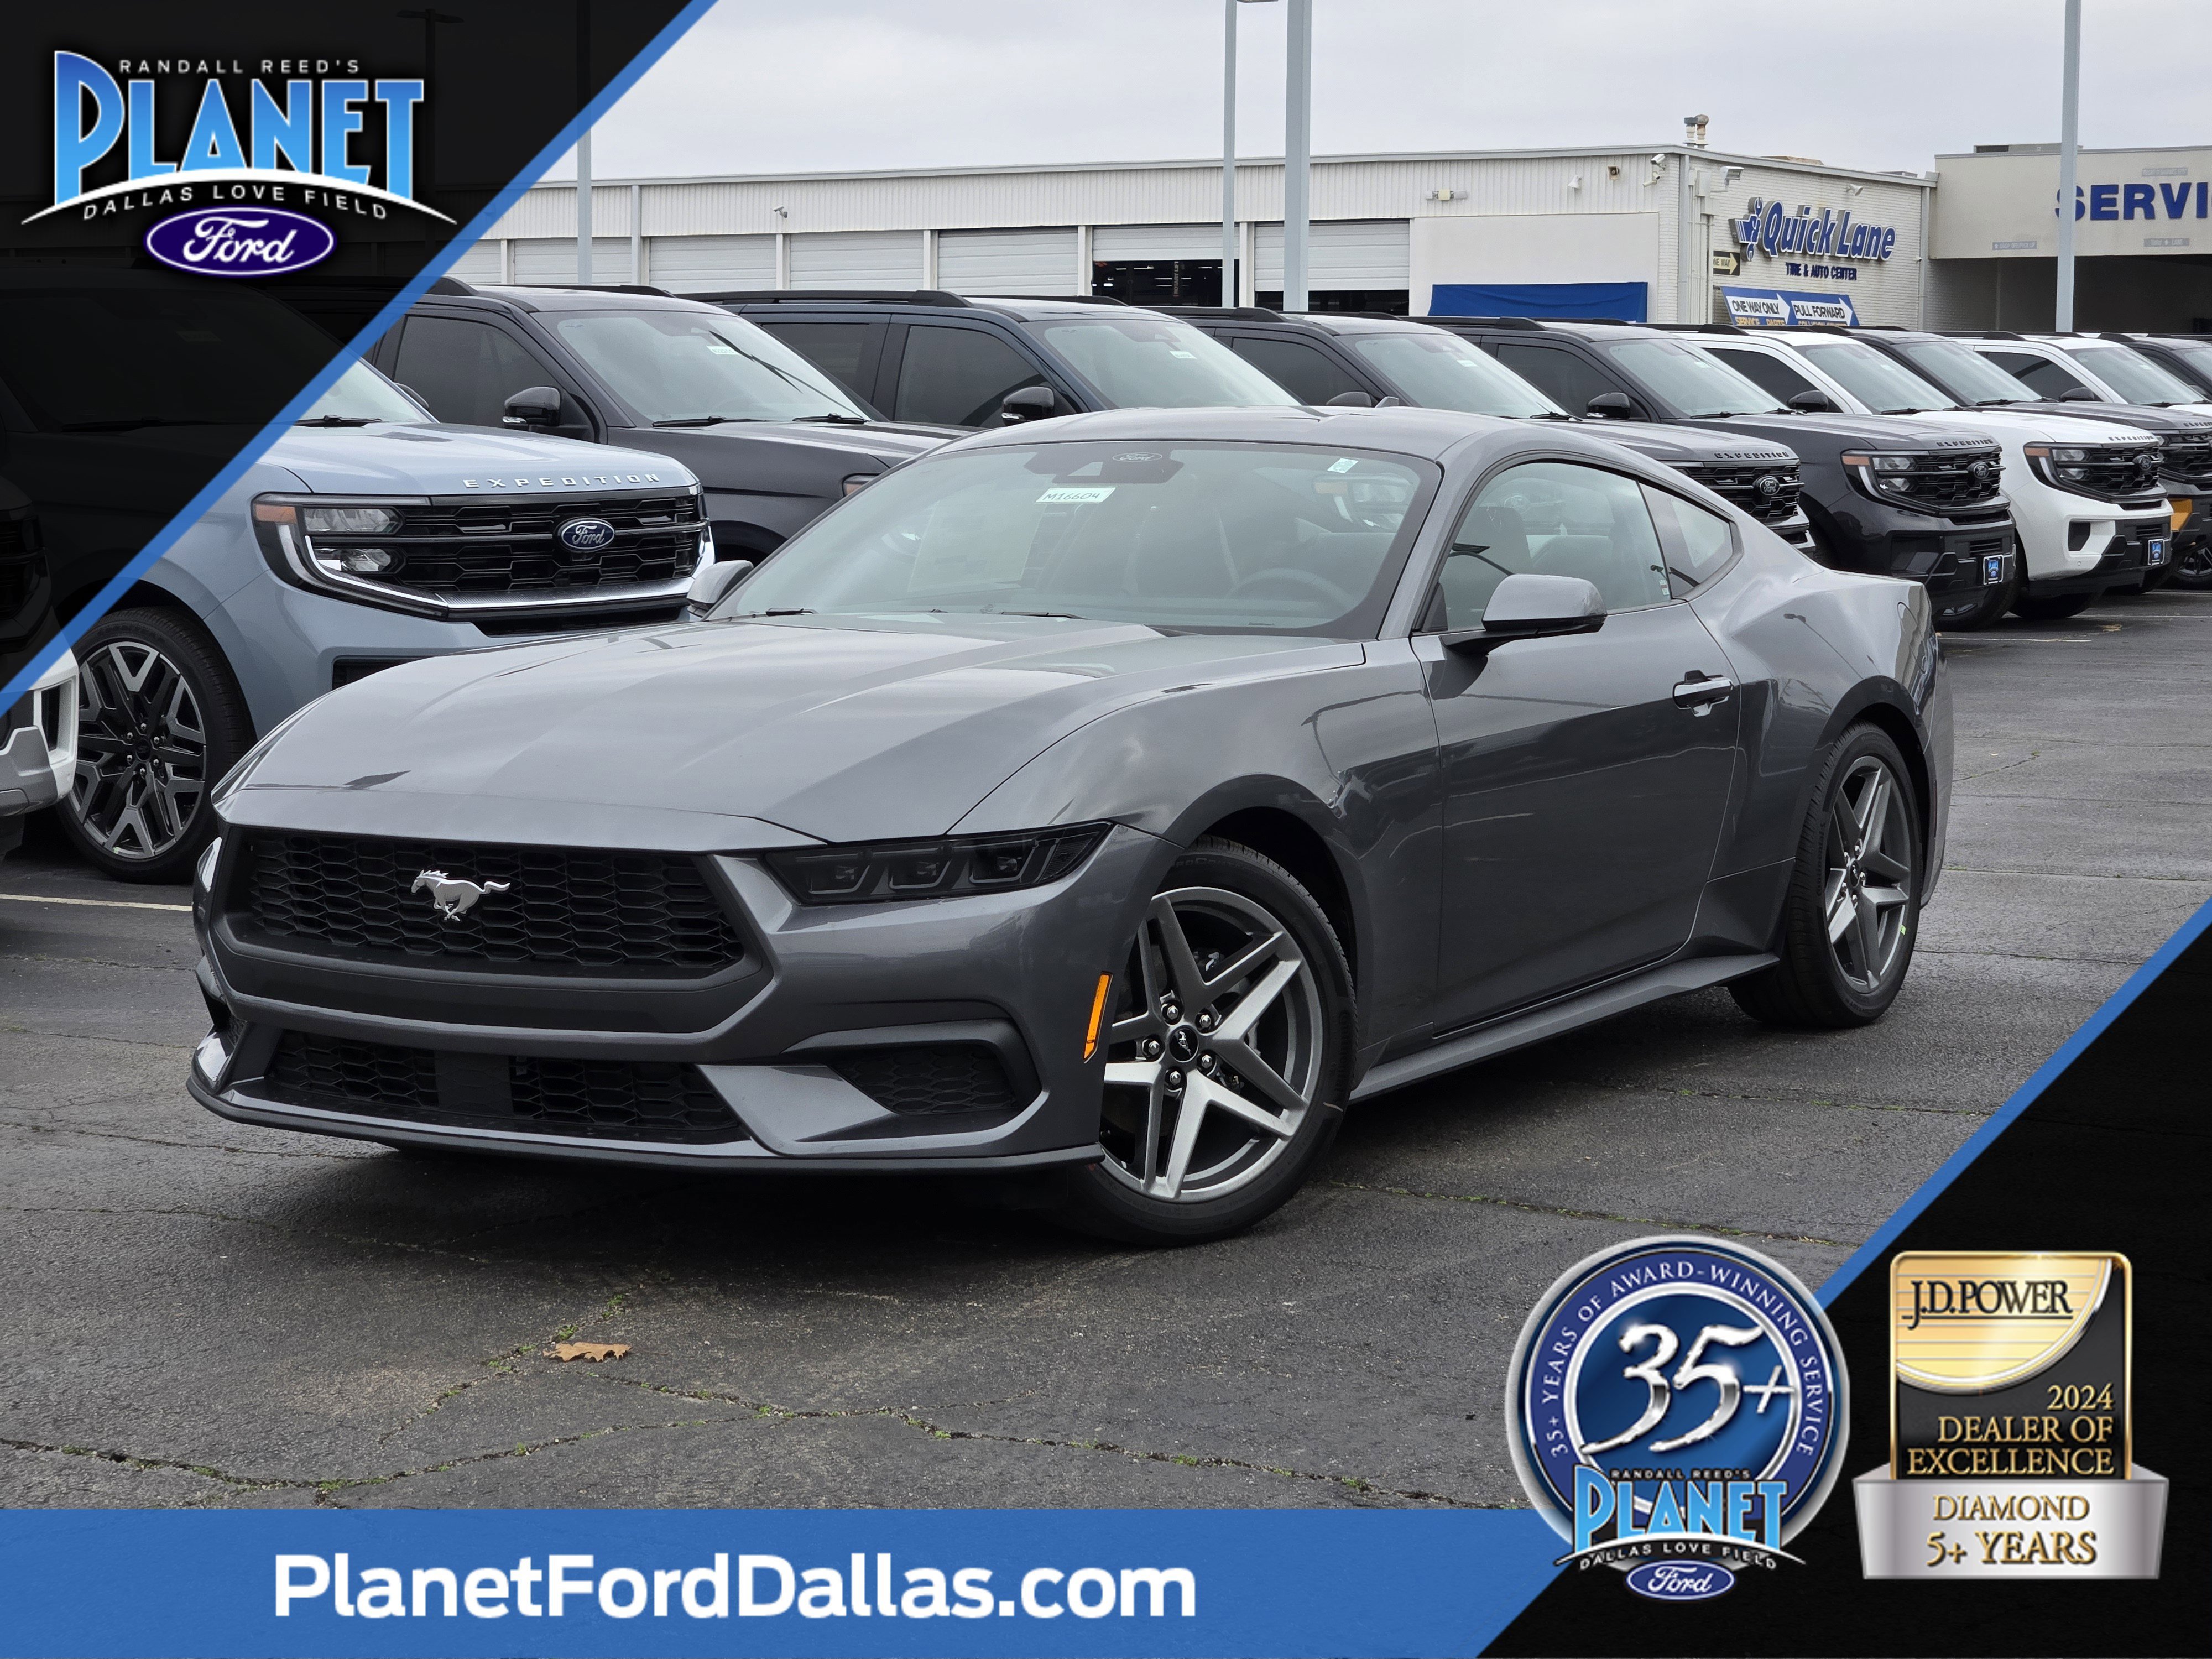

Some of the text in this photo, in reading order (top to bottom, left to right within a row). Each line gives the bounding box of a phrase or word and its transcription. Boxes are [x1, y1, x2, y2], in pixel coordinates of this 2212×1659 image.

[1763, 200, 1896, 261] Quick Lane
[1786, 262, 1857, 280] TIRE & AUTO CENTER
[1732, 300, 1780, 315] ONE WAY ONLY
[1793, 304, 1845, 319] PULL FORWARD
[462, 473, 660, 488] EXPEDITION
[1043, 492, 1101, 500] M16604
[572, 525, 606, 545] Ford
